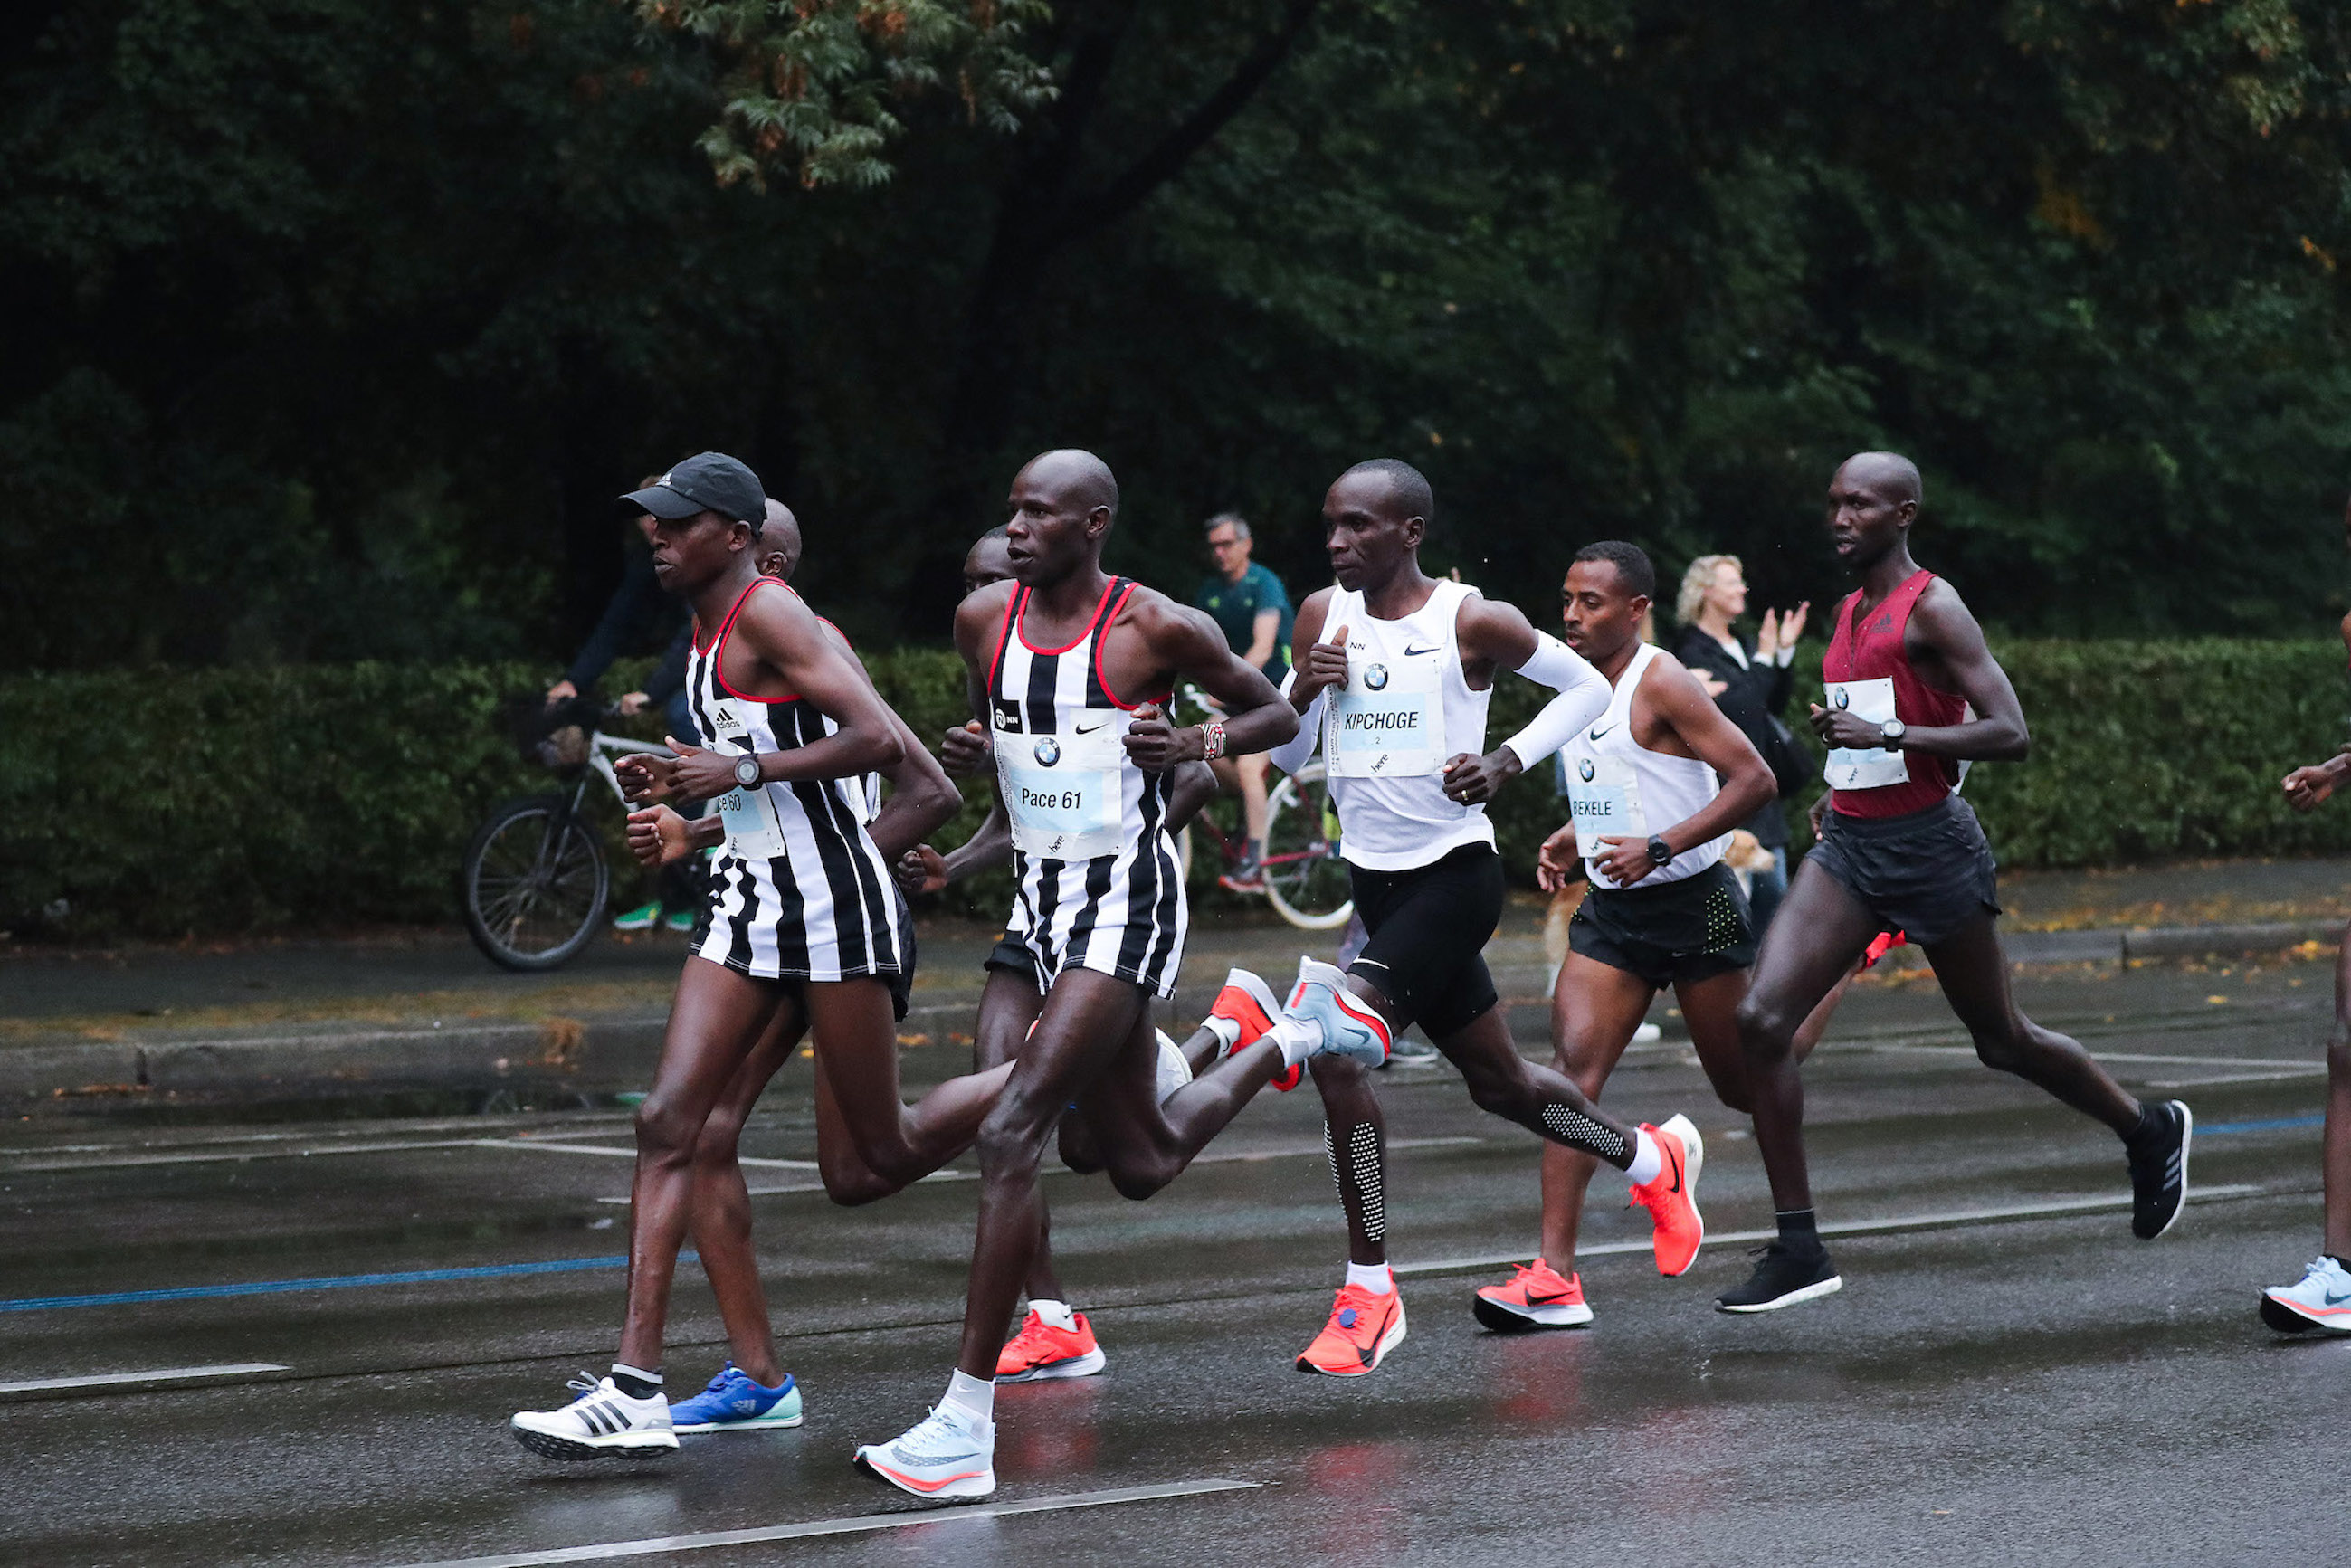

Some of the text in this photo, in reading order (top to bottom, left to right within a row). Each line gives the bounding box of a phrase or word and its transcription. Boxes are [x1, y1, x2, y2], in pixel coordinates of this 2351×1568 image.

[1349, 641, 1366, 651] NN
[1345, 711, 1419, 730] KIPCHOGE
[1375, 736, 1381, 745] 2
[1370, 754, 1389, 773] here
[728, 794, 741, 812] 60
[1022, 787, 1081, 809] Pace 61
[1573, 801, 1612, 815] BEKELE
[1048, 835, 1065, 853] here
